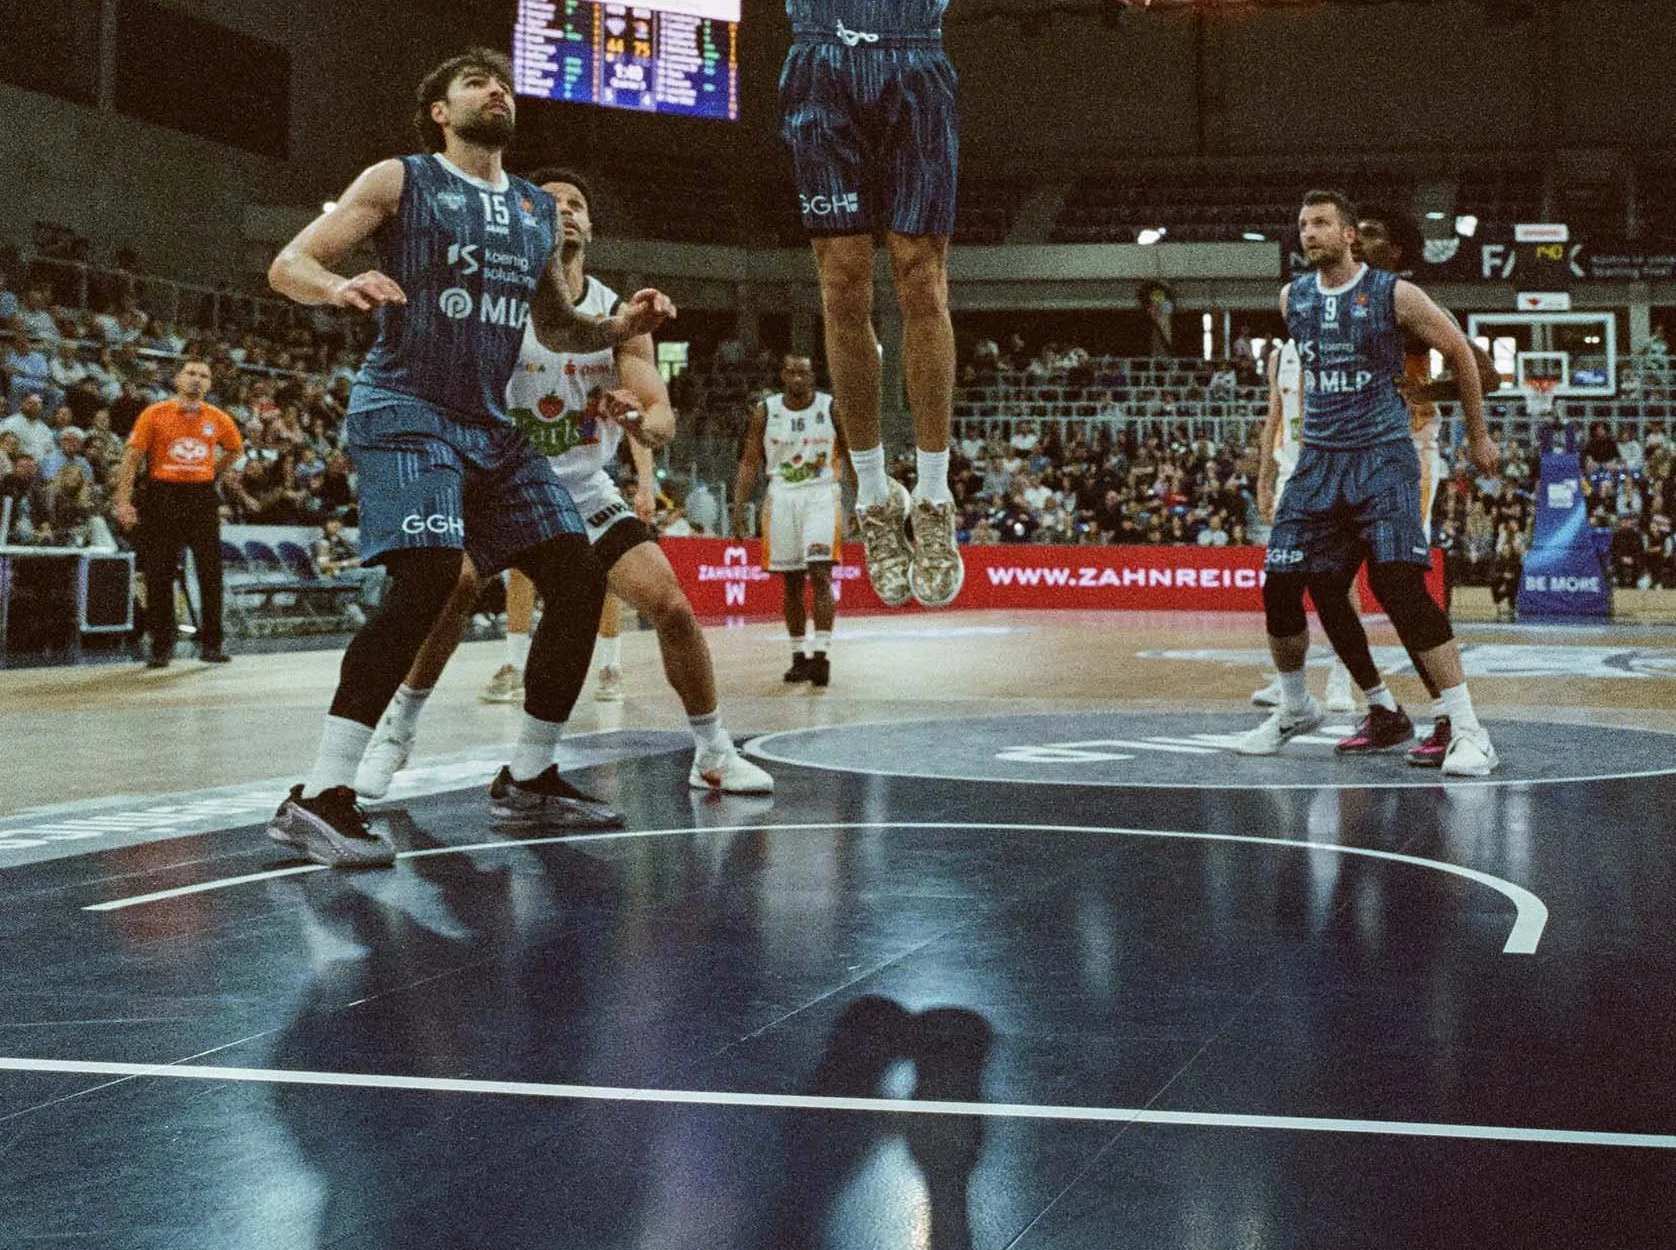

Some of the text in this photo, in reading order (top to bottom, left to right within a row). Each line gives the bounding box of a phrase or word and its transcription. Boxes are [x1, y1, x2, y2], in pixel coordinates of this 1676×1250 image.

[478, 192, 510, 227] 15
[1324, 297, 1337, 321] 9
[1320, 370, 1373, 393] MLP
[791, 418, 805, 432] 16
[724, 582, 746, 606] W
[1525, 576, 1600, 593] BE MORE
